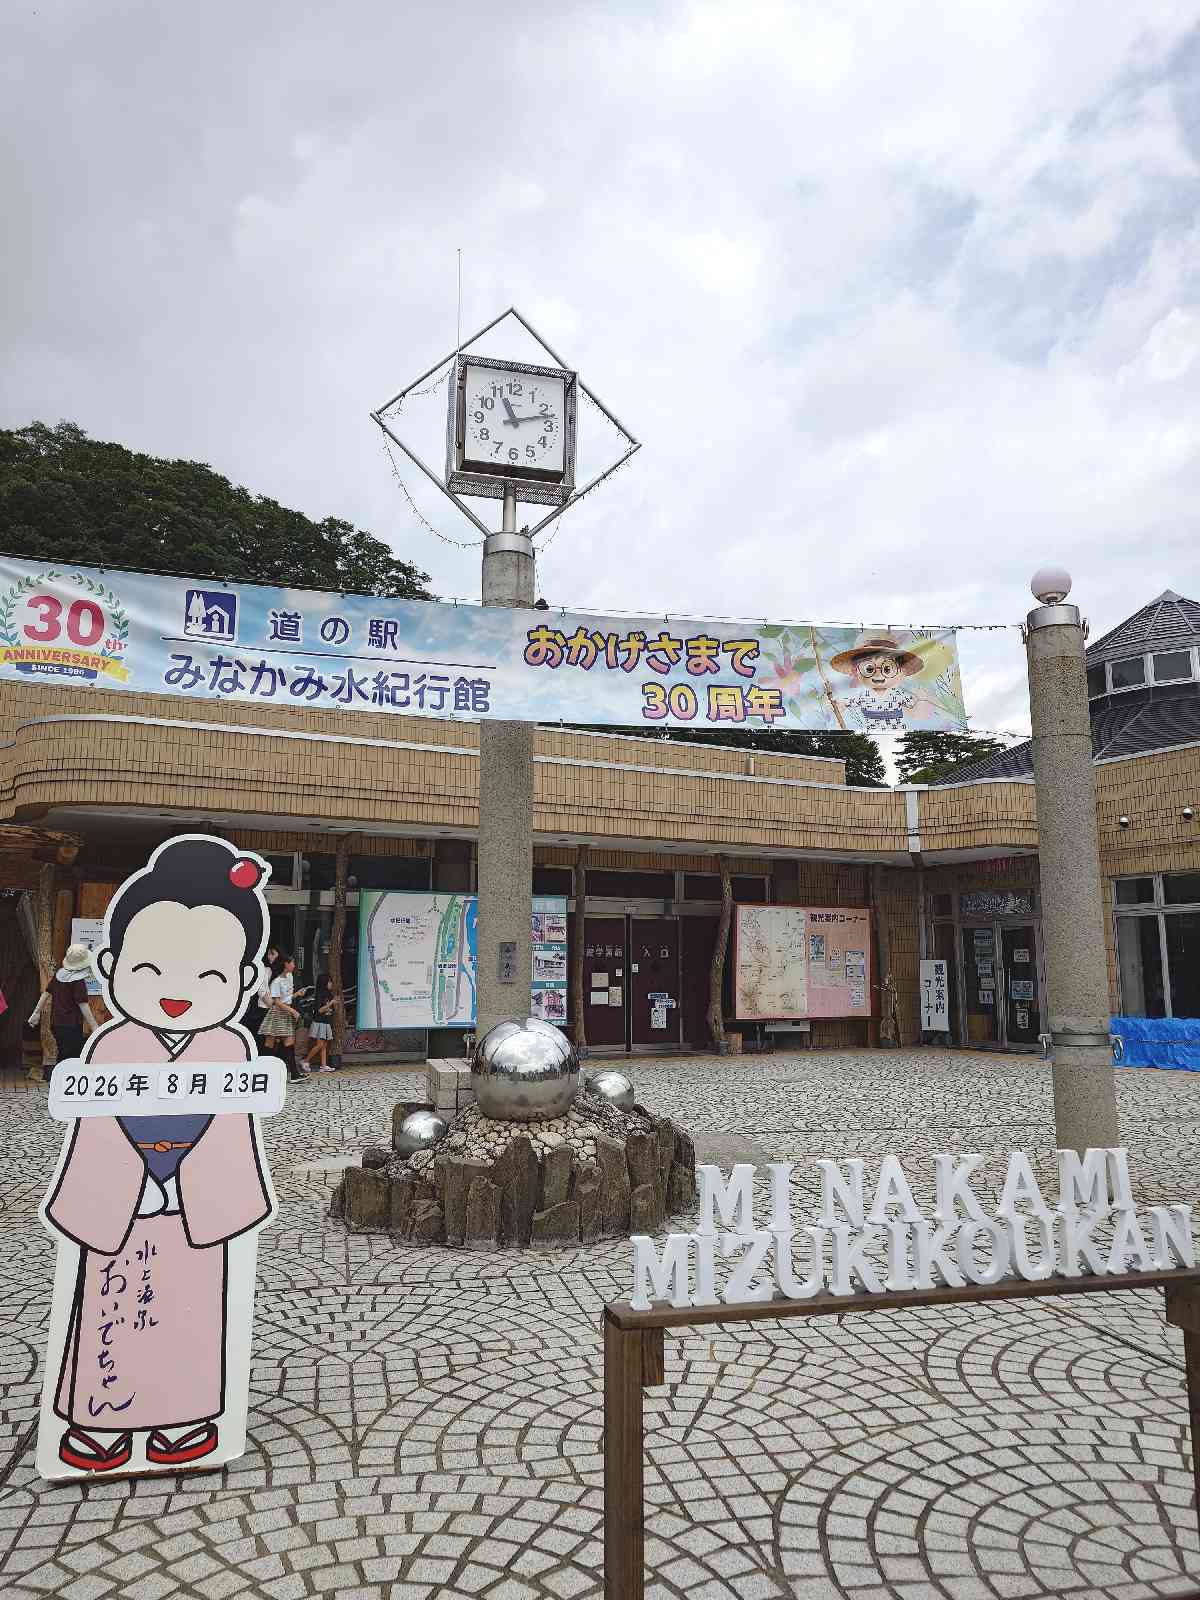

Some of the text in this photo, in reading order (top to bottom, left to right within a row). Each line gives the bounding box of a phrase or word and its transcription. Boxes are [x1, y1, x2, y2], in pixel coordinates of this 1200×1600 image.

[490, 385, 503, 398] 11
[506, 383, 522, 396] 12
[480, 396, 494, 410] 10
[529, 391, 535, 403] 1
[539, 403, 549, 416] 2
[474, 411, 484, 423] 9
[544, 420, 553, 432] 3
[480, 428, 489, 440] 8
[493, 441, 503, 454] 7
[538, 436, 547, 448] 4
[509, 448, 518, 461] 6
[526, 445, 535, 458] 5
[270, 609, 399, 650] 道の駅
[523, 624, 761, 679] おかげさまで
[3, 648, 110, 669] ANNIVERSARY
[164, 653, 491, 713] みなかみ水紀行館
[810, 912, 867, 924] 観光案内コーナー
[934, 963, 945, 1014] 観光案内
[924, 979, 933, 1027] コーナー
[63, 1072, 269, 1097] 2026年 8月 23日
[697, 1147, 1137, 1235] MINAKAMI
[629, 1204, 1195, 1311] MIZUKIKOUKAN
[88, 1259, 136, 1417] おいでちゃん
